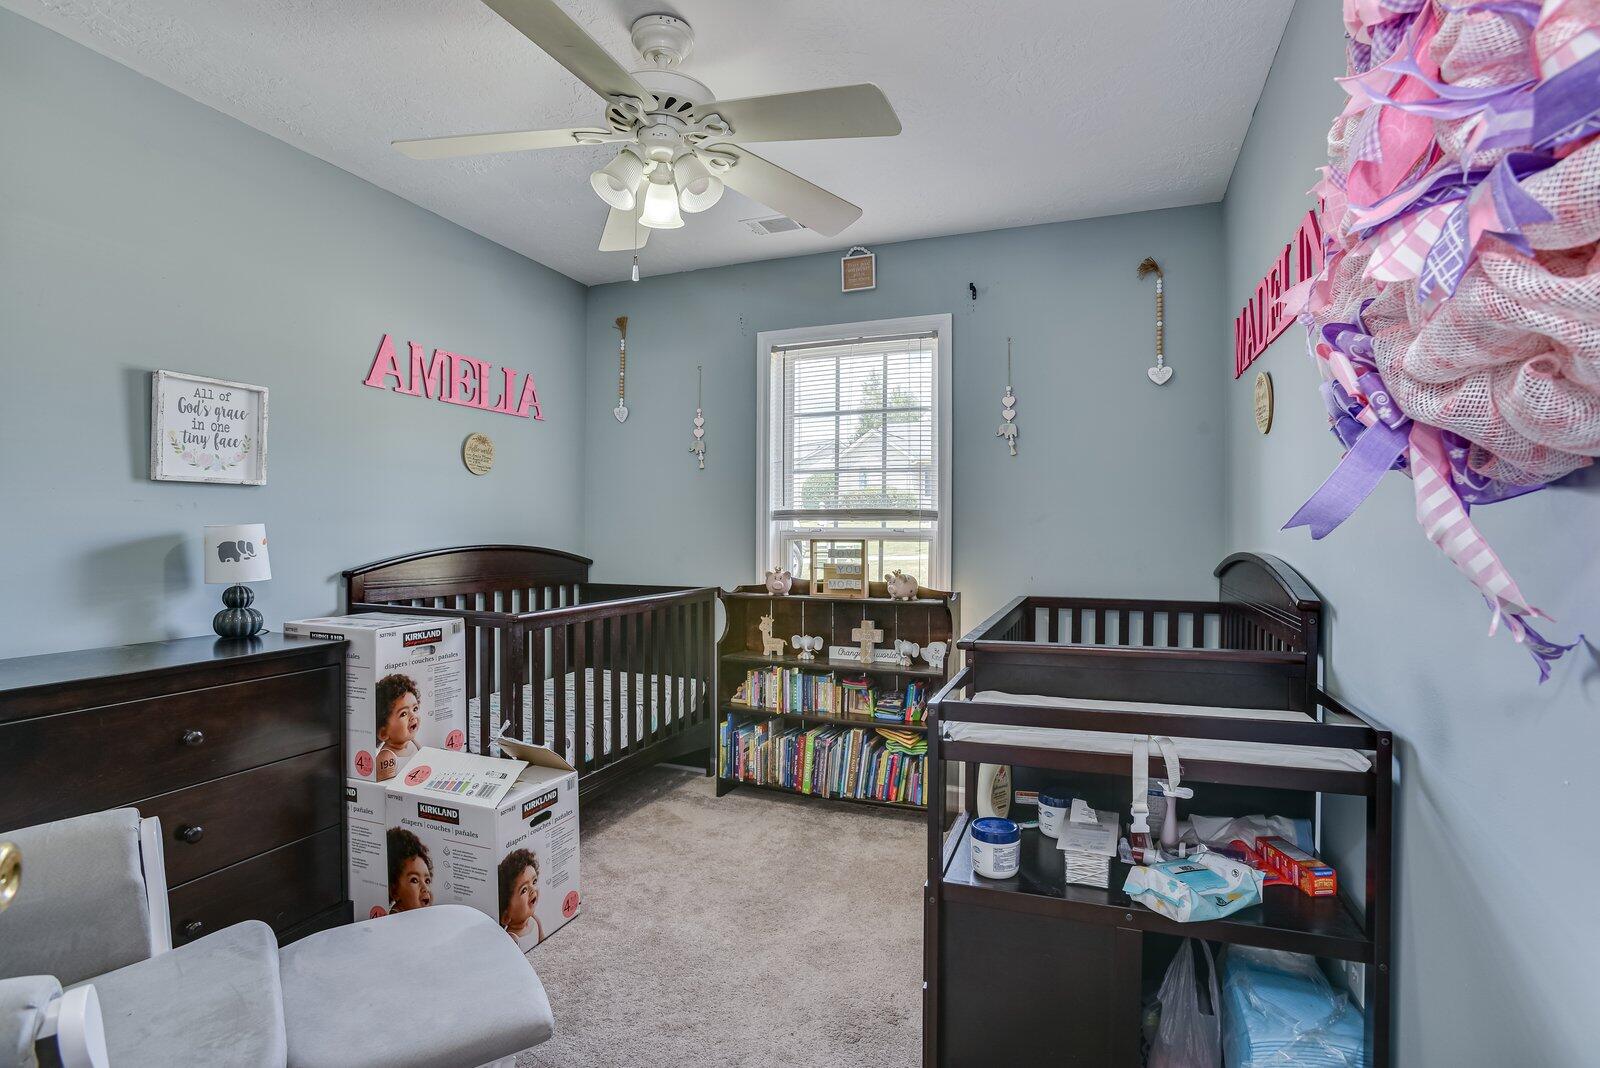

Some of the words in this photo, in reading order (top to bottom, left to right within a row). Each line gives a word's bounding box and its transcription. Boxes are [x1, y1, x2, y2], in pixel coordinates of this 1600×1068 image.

[363, 334, 545, 421] AMELIA
[194, 388, 214, 399] All
[219, 392, 231, 402] of
[178, 396, 211, 417] God's
[214, 406, 250, 422] grace
[192, 418, 205, 430] in
[211, 422, 230, 433] one
[180, 429, 210, 449] tiny
[214, 433, 242, 451] face
[837, 565, 860, 573] YOU
[828, 580, 860, 588] MORE
[405, 630, 441, 642] KIRKLAND
[837, 647, 861, 657] Chang
[384, 662, 408, 670] diapers
[411, 656, 434, 665] couches
[438, 652, 459, 662] pañales
[357, 756, 364, 769] 4
[380, 758, 395, 769] 198
[408, 769, 420, 780] 4
[523, 790, 557, 812] KIRKLAND
[353, 806, 374, 815] pañales
[420, 804, 458, 819] KIRKLAND
[401, 817, 423, 828] diapers
[426, 823, 451, 833] couches
[455, 828, 479, 838] pañales
[505, 834, 527, 849] diapers
[530, 821, 552, 836] couches
[563, 899, 571, 912] 4
